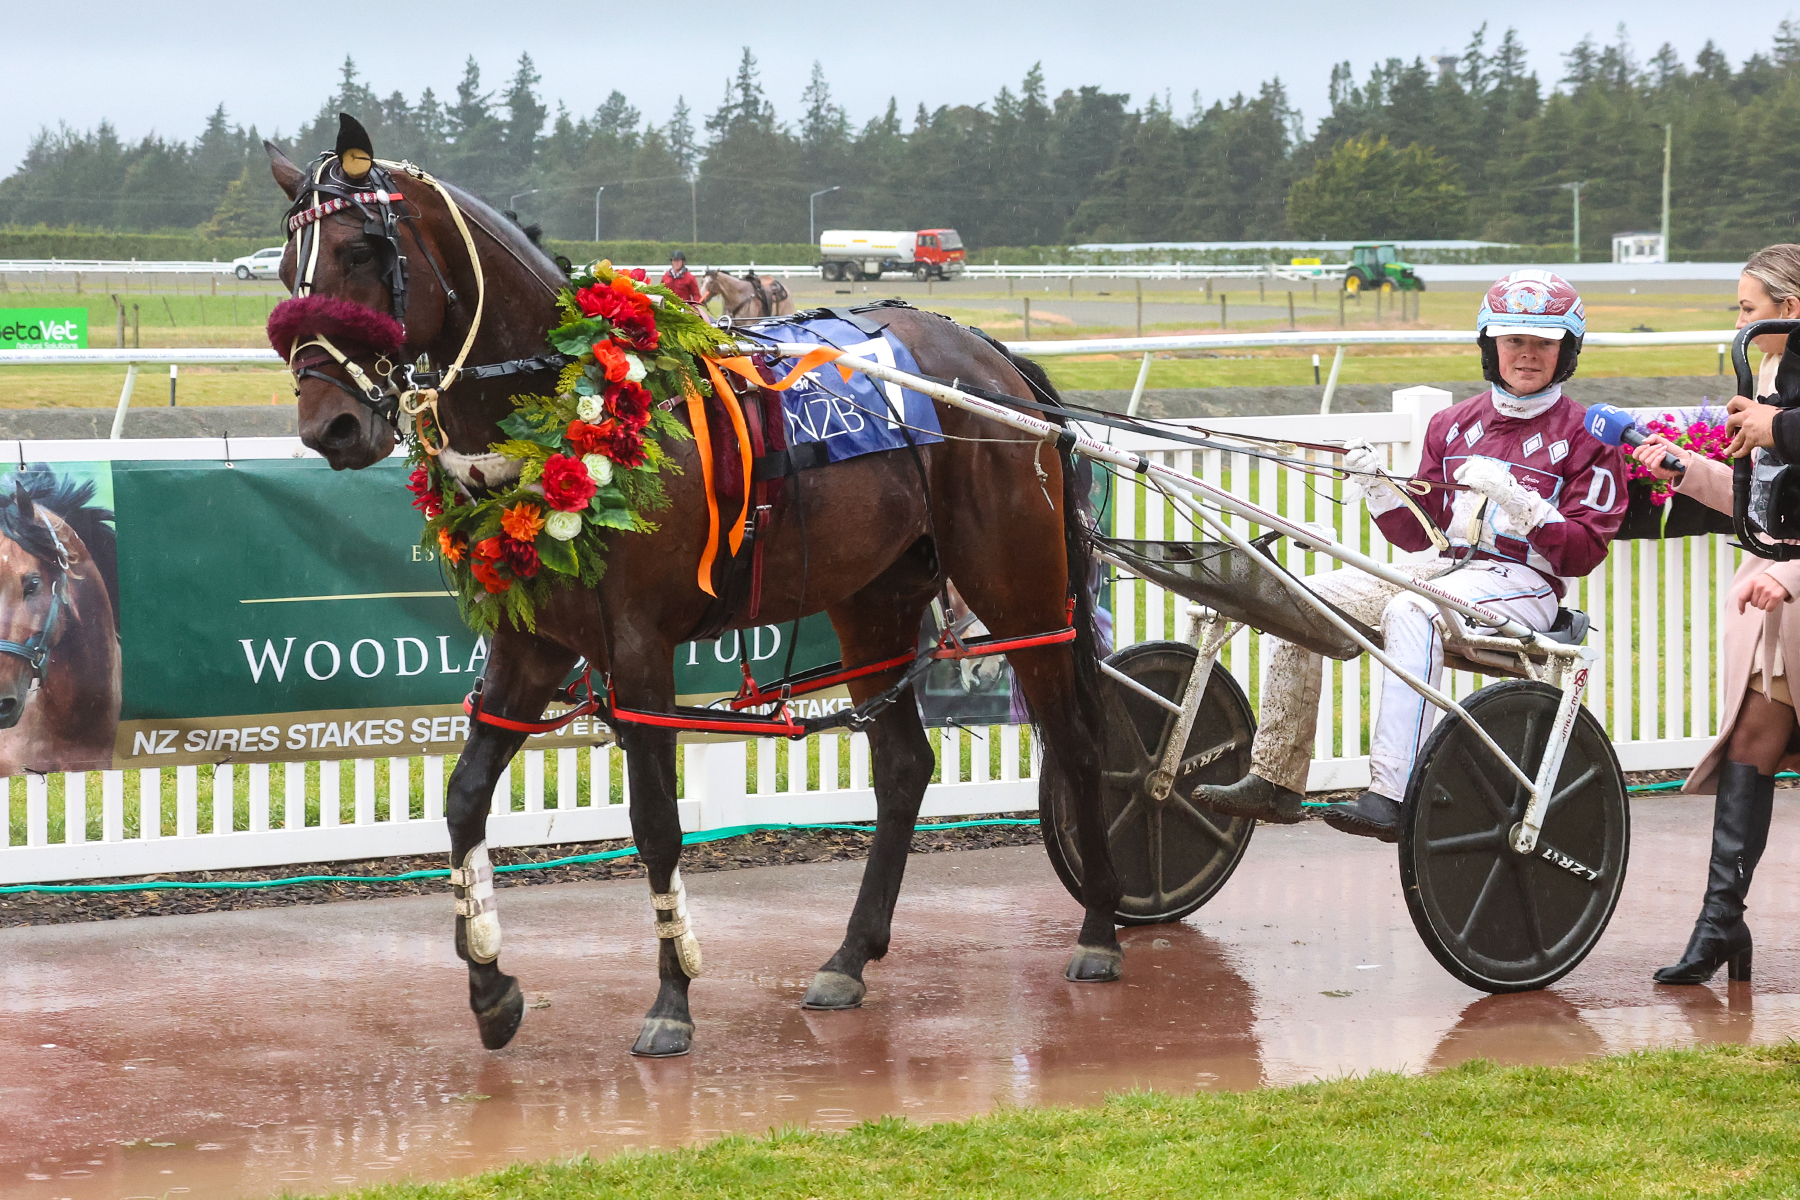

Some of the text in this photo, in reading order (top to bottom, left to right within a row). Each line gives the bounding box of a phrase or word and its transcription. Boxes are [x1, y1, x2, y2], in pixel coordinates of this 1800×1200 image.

[0, 320, 79, 341] etaVet
[784, 396, 865, 446] NZB
[1579, 464, 1617, 513] D
[1471, 603, 1499, 621] Lodge
[238, 635, 490, 684] WOODLA
[781, 697, 853, 721] STAKE
[132, 715, 470, 756] NZ SIRES STAKES SER
